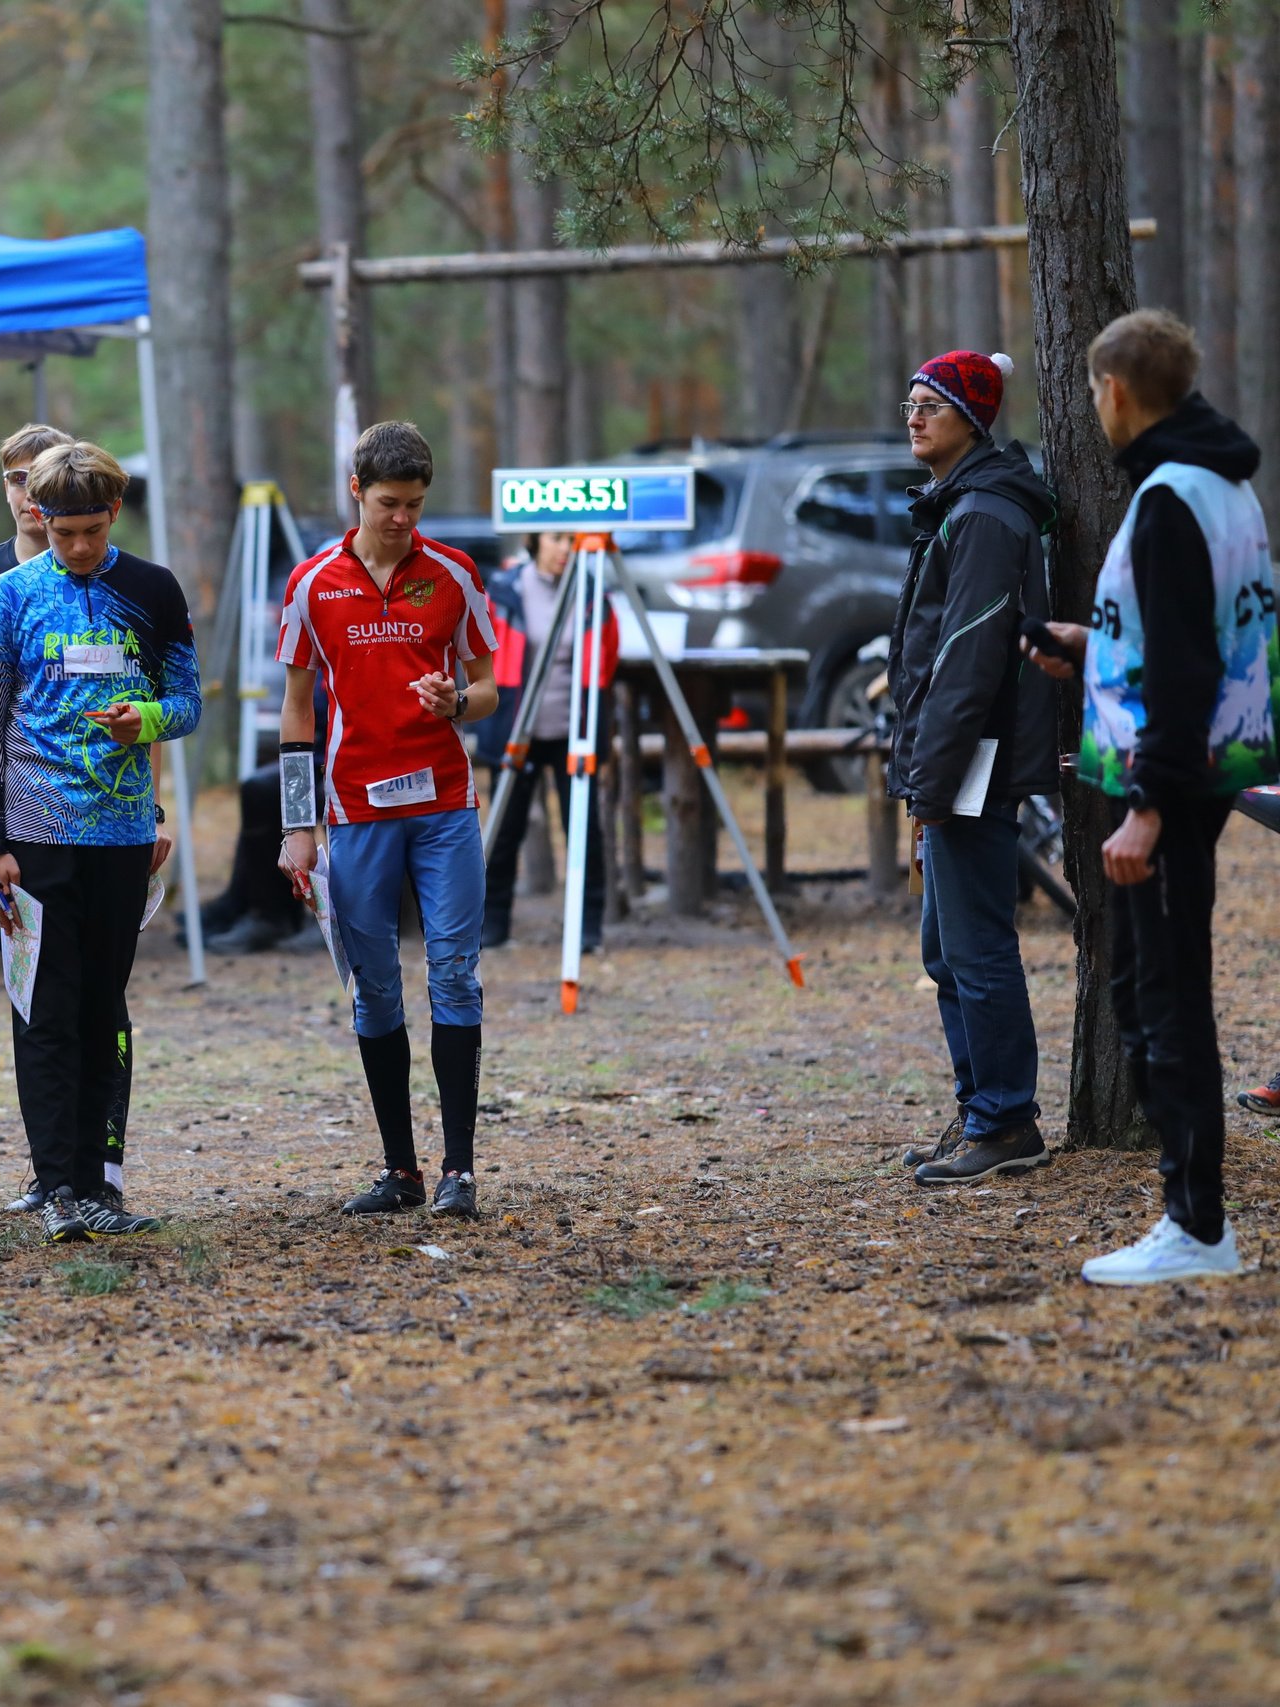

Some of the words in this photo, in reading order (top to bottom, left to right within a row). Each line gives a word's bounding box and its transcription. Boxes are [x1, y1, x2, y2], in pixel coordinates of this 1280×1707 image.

[501, 477, 628, 513] 00:05.51
[317, 587, 364, 602] RUSSIA
[346, 621, 424, 640] SUUNTO
[386, 775, 413, 793] 201
